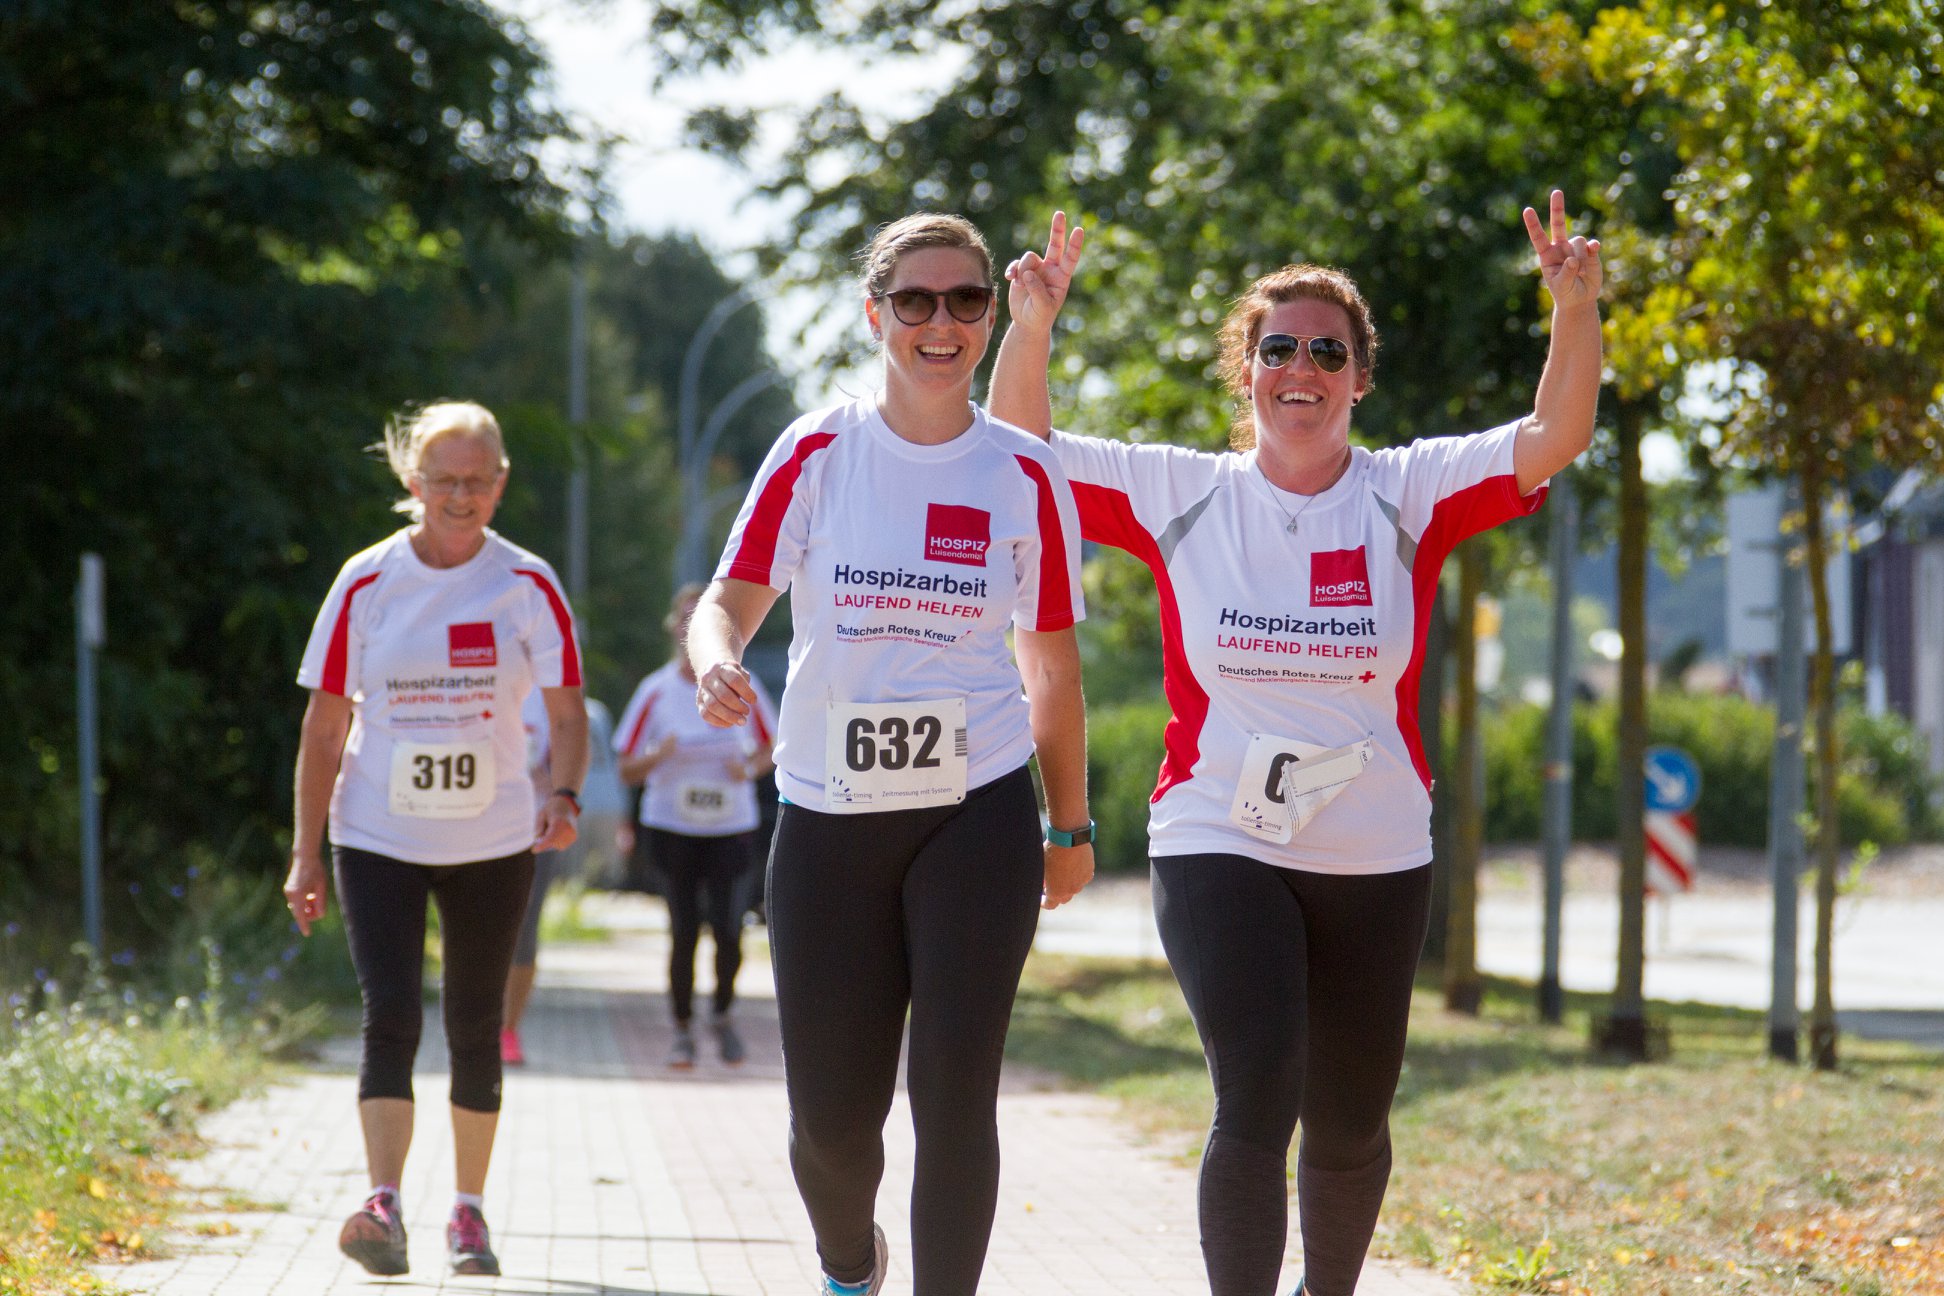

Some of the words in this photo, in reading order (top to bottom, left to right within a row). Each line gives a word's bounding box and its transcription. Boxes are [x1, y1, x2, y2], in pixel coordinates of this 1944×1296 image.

[930, 536, 986, 552] HOSPIZ
[834, 564, 987, 598] Hospizarbeit
[1315, 580, 1366, 596] HOSPIZ
[834, 594, 911, 610] LAUFEND
[917, 599, 984, 618] HELFEN
[1219, 608, 1377, 636] Hospizarbeit
[836, 624, 884, 637] Deutsches
[888, 624, 921, 637] Rotes
[924, 628, 957, 643] Kreuz
[1217, 635, 1301, 655] LAUFEND
[1308, 644, 1378, 659] HELFEN
[1218, 664, 1279, 677] Deutsches
[1281, 669, 1316, 679] Rotes
[1319, 672, 1354, 681] Kreuz
[386, 675, 496, 691] Hospizarbeit
[388, 694, 444, 705] LAUFEND
[846, 715, 942, 772] 632
[412, 753, 476, 790] 319
[882, 789, 919, 798] Zeitmessung
[931, 787, 953, 795] System
